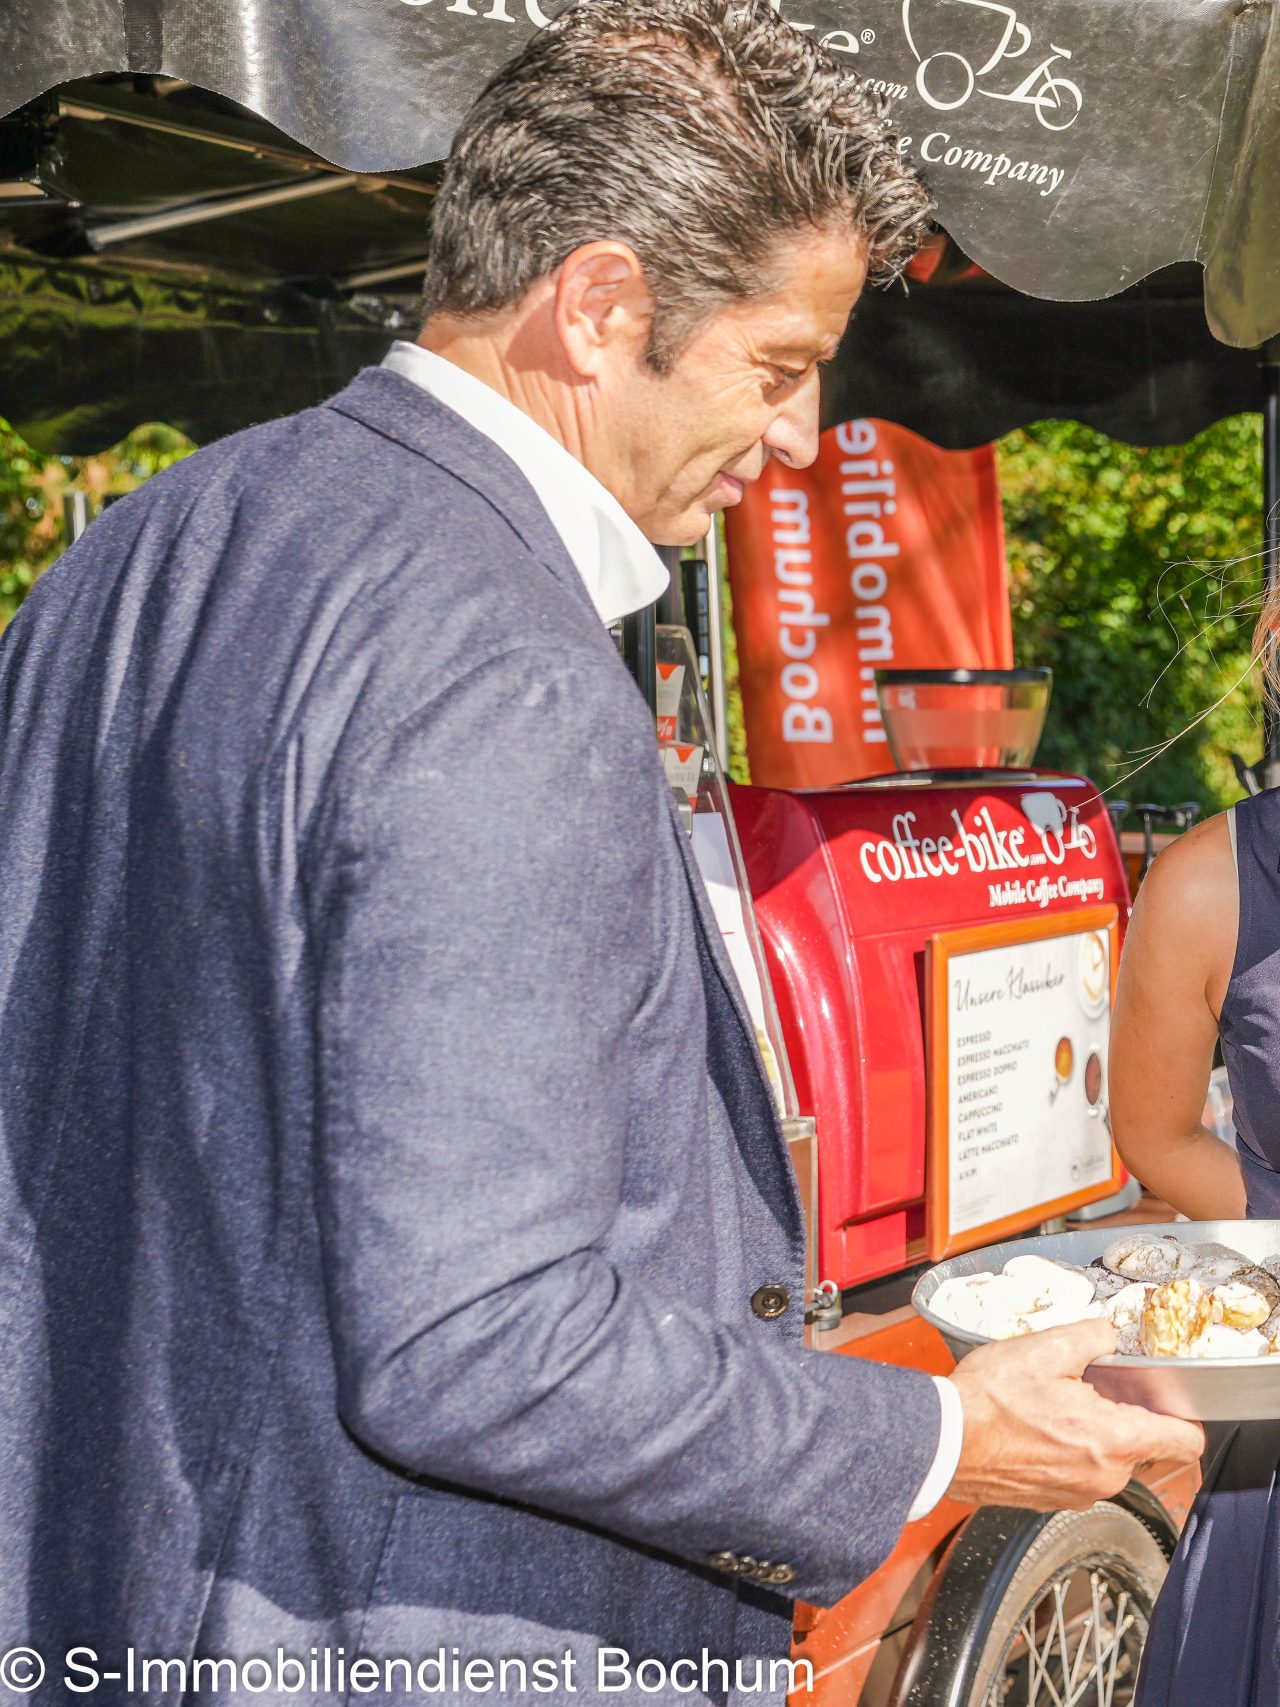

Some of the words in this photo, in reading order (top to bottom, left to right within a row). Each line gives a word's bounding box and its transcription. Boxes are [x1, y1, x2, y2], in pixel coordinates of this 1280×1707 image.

[920, 132, 1065, 197] Company
[860, 806, 1030, 883] coffee-bike
[988, 880, 1027, 908] Mobile
[1025, 875, 1059, 908] Coffee
[1057, 875, 1104, 902] Company
[954, 978, 1005, 1012] Unsere
[957, 1030, 992, 1048] ESPRESSO
[957, 1049, 992, 1067] ESPRESSO
[993, 1039, 1030, 1056] MACCHIATO
[957, 1067, 992, 1086] ESPRESSO
[958, 1084, 999, 1104] AMERICANO
[958, 1102, 1003, 1123] CAPPUCCINO
[958, 1127, 975, 1142] FLAT
[976, 1121, 998, 1136] WHITE
[958, 1146, 980, 1161] LATTE
[981, 1133, 1019, 1153] MACCHIATO
